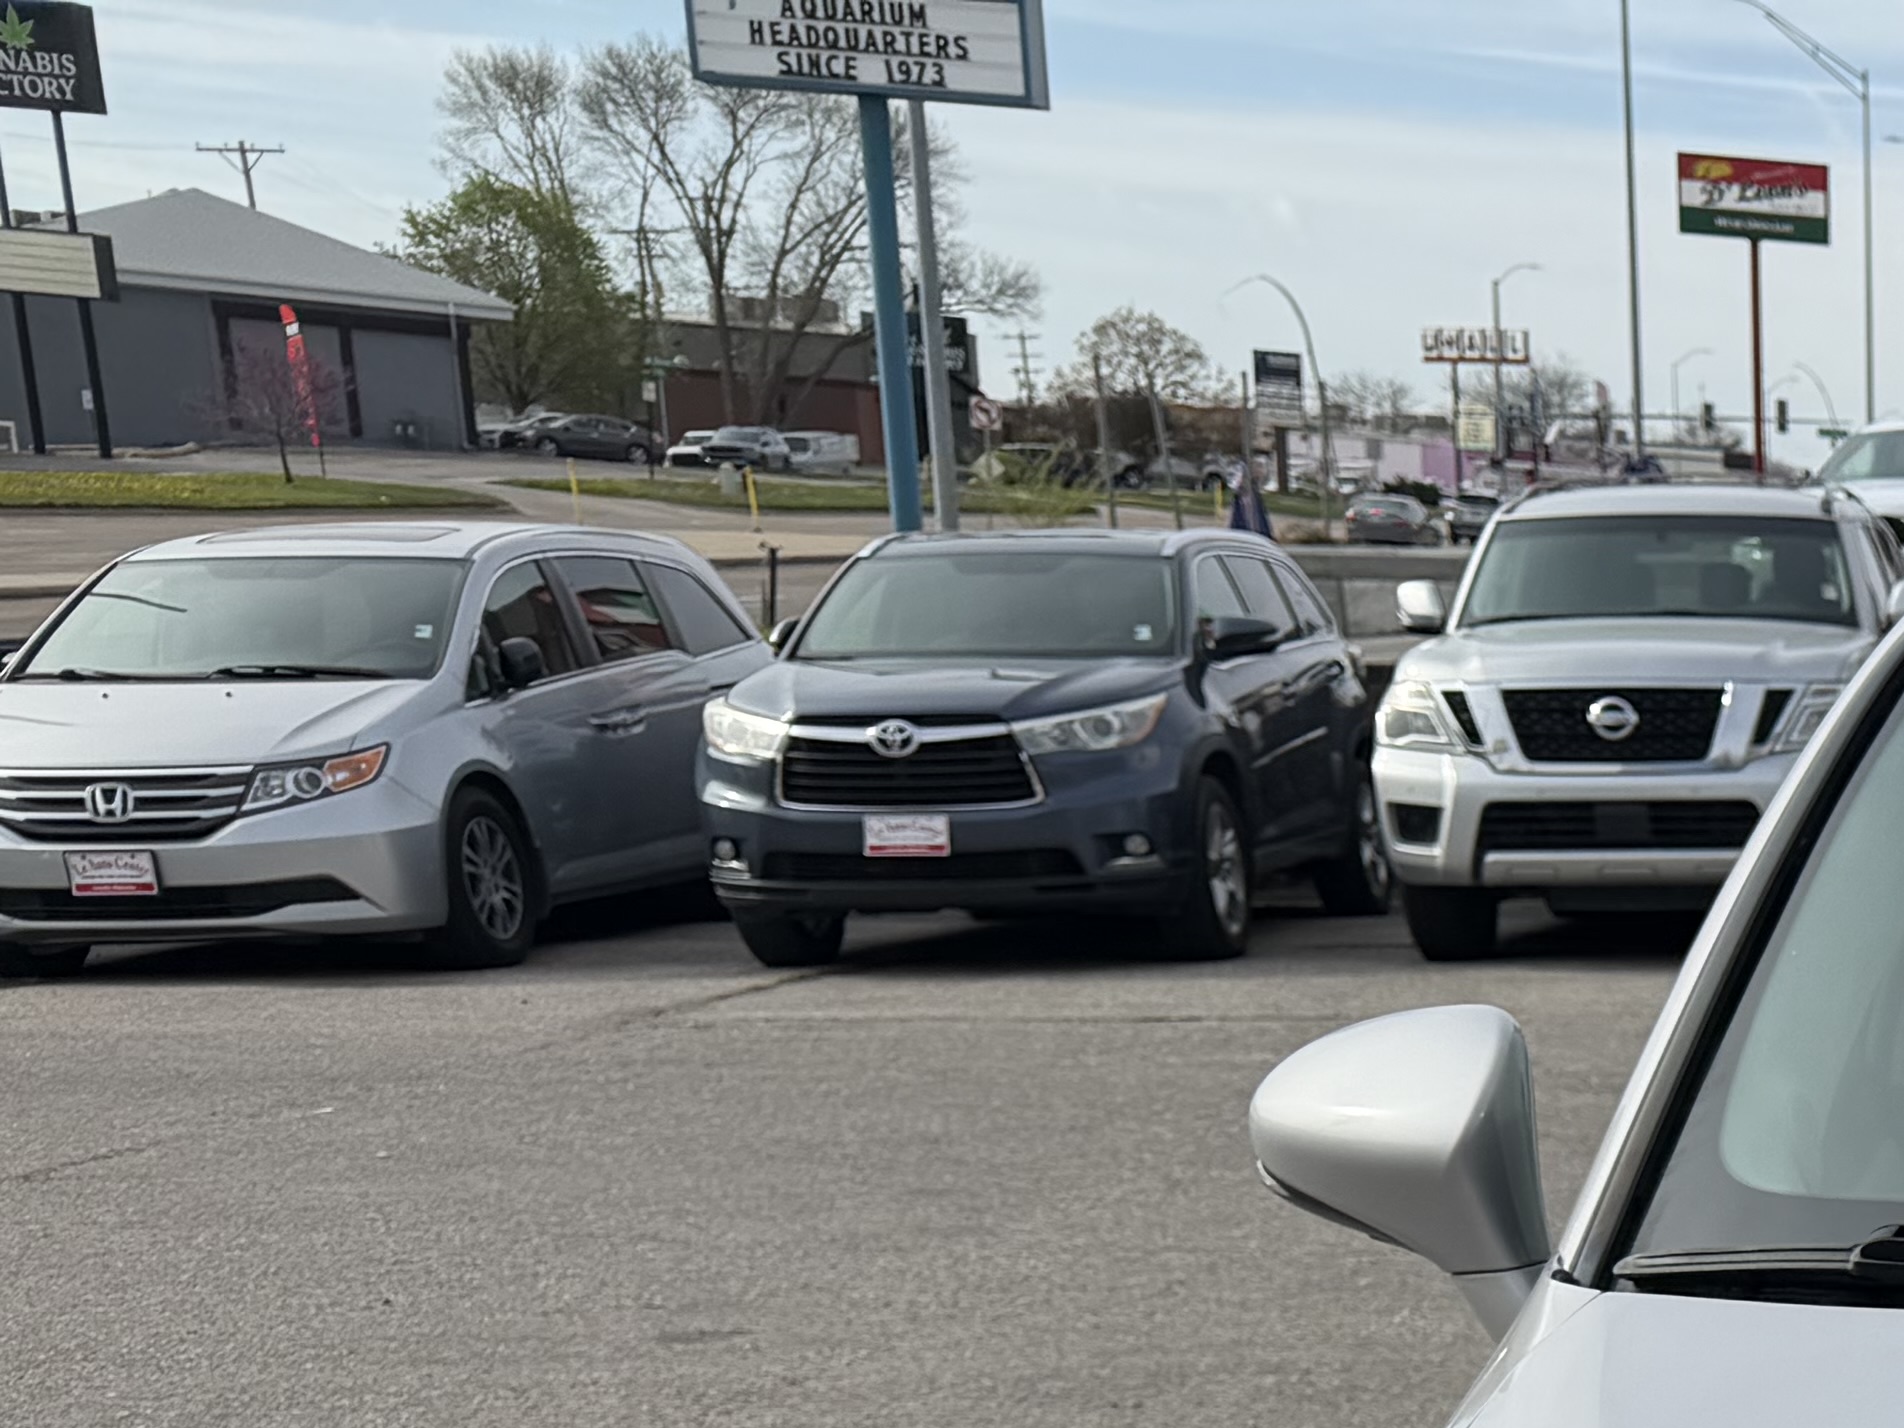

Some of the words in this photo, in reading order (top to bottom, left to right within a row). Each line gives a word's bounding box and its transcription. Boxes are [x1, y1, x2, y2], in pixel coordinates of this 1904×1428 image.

[780, 0, 928, 28] AQUARIUM
[748, 20, 969, 61] HEADQUARTERS
[777, 50, 858, 81] SINCE
[884, 58, 947, 88] 1973
